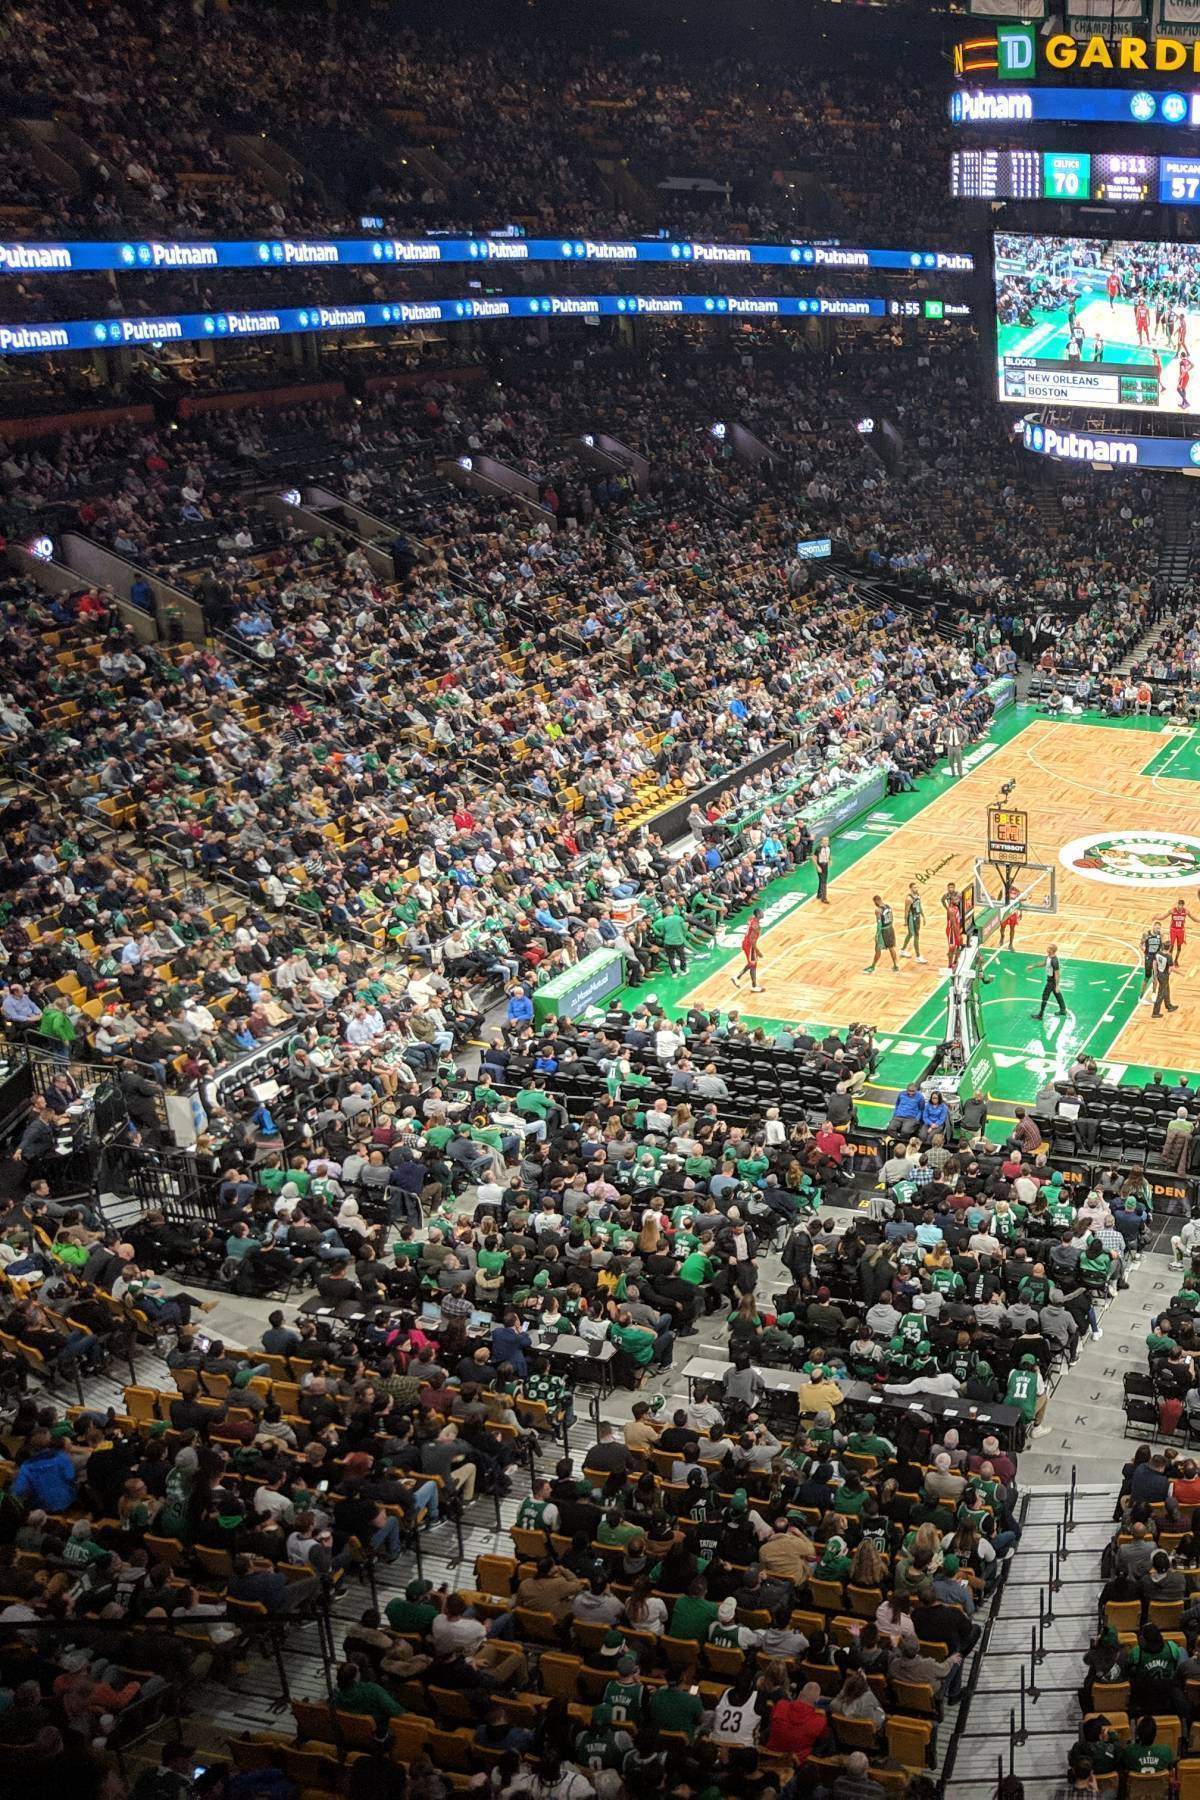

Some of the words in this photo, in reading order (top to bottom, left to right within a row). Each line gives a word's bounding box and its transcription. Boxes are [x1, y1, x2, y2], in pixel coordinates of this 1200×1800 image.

[1073, 20, 1129, 36] CHAMPIONS
[1000, 34, 1032, 70] TD
[962, 91, 1032, 120] Putnam
[1053, 173, 1079, 194] 70
[1171, 177, 1200, 199] 57
[153, 244, 218, 265] Putnam
[284, 243, 339, 262] Putnam
[394, 242, 441, 261] Putnam
[488, 242, 528, 259] Putnam
[585, 242, 638, 260] Putnam
[693, 244, 751, 262] Putnam
[814, 249, 869, 266] Putnam
[401, 303, 442, 321] Putnam
[472, 300, 510, 316] Putnam
[552, 298, 599, 314] Putnam
[637, 298, 683, 312] Putnam
[728, 299, 778, 313] Putnam
[820, 299, 870, 315] Putnam
[891, 301, 920, 316] 8:55
[944, 304, 970, 315] Bank
[228, 314, 280, 333] Putnam
[321, 308, 366, 327] Putnam
[0, 327, 69, 349] Putnam
[124, 320, 182, 341] Putnam
[1005, 357, 1037, 368] BLOCKS
[1027, 372, 1051, 385] NEW
[1052, 373, 1100, 387] ORLEANS
[1028, 386, 1069, 399] BOSTON
[1044, 429, 1138, 465] Putnam
[851, 1145, 878, 1156] DEN
[1152, 1282, 1165, 1290] D
[1142, 1303, 1154, 1312] E
[1130, 1322, 1143, 1331] F
[1118, 1345, 1130, 1354] G
[1103, 1367, 1117, 1377] H
[1014, 1382, 1029, 1399] 11
[1090, 1392, 1102, 1401] J
[1074, 1415, 1089, 1426] K
[1061, 1439, 1072, 1450] L
[1043, 1463, 1061, 1476] M
[611, 1695, 633, 1706] TATUM
[719, 1709, 743, 1733] 23
